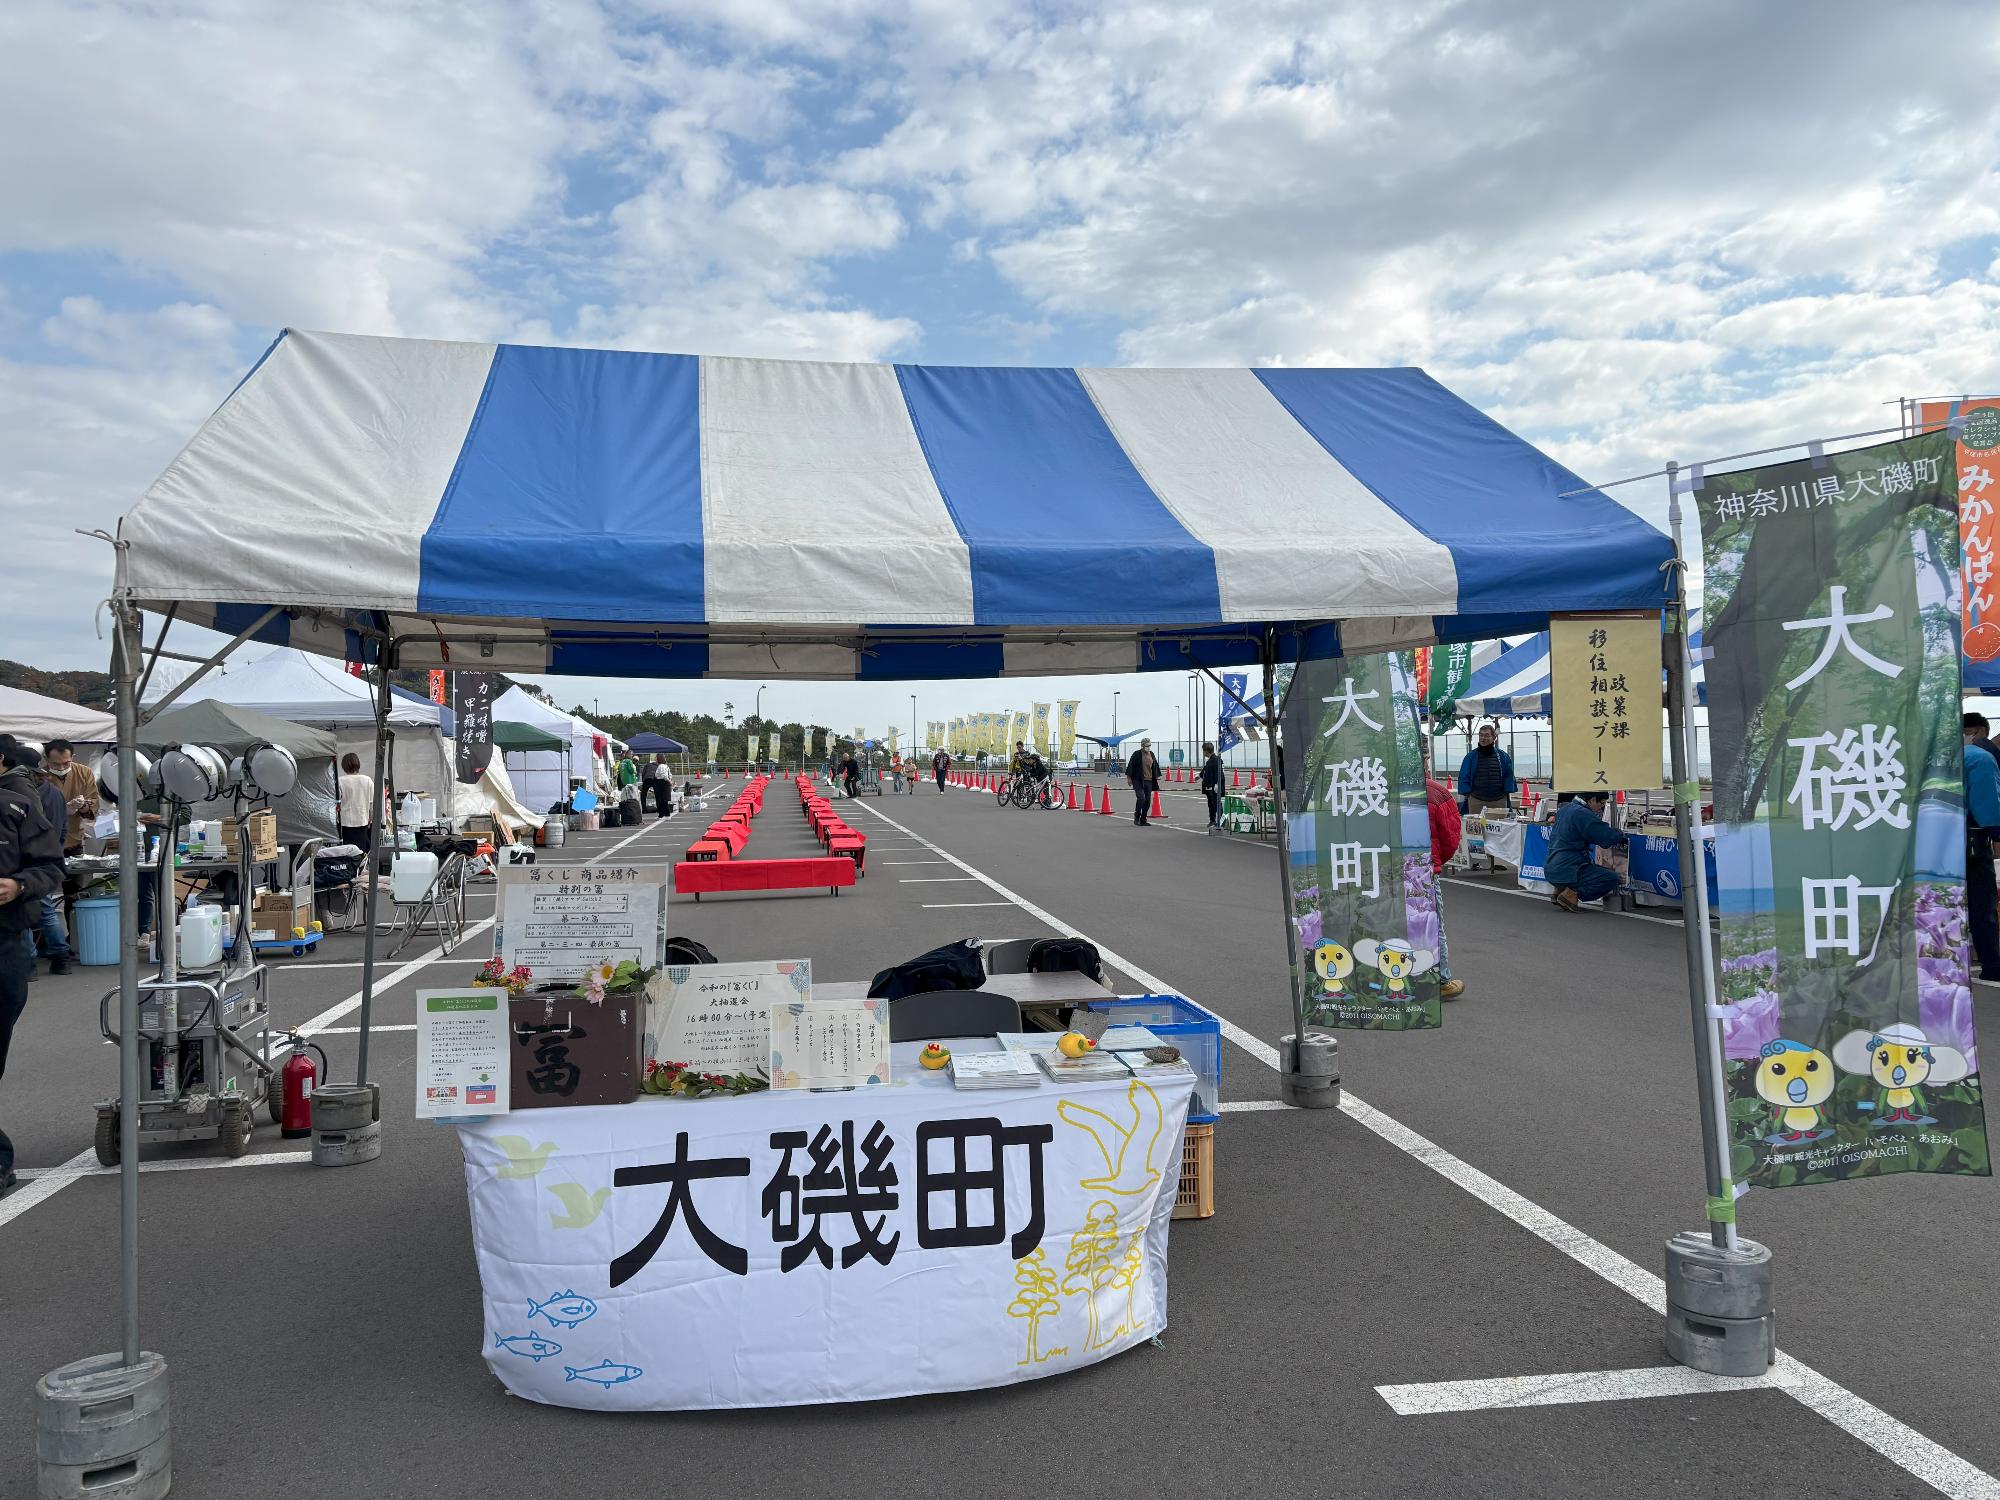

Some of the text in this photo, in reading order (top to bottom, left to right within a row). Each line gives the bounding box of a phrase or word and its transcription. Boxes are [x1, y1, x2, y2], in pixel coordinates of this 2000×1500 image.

[1713, 455, 1943, 523] 神奈川県大磯町
[1958, 464, 1995, 613] みかんぱん
[1588, 628, 1610, 785] 移住相談ブース
[1609, 674, 1631, 739] 政策課
[1321, 677, 1391, 899] 大磯町
[1782, 585, 1912, 967] 大磯町
[581, 867, 639, 881] 商品紹介
[709, 996, 750, 1007] 大抽選会
[609, 1117, 1054, 1288] 大磯町
[1842, 1146, 1908, 1164] OISOMACHI
